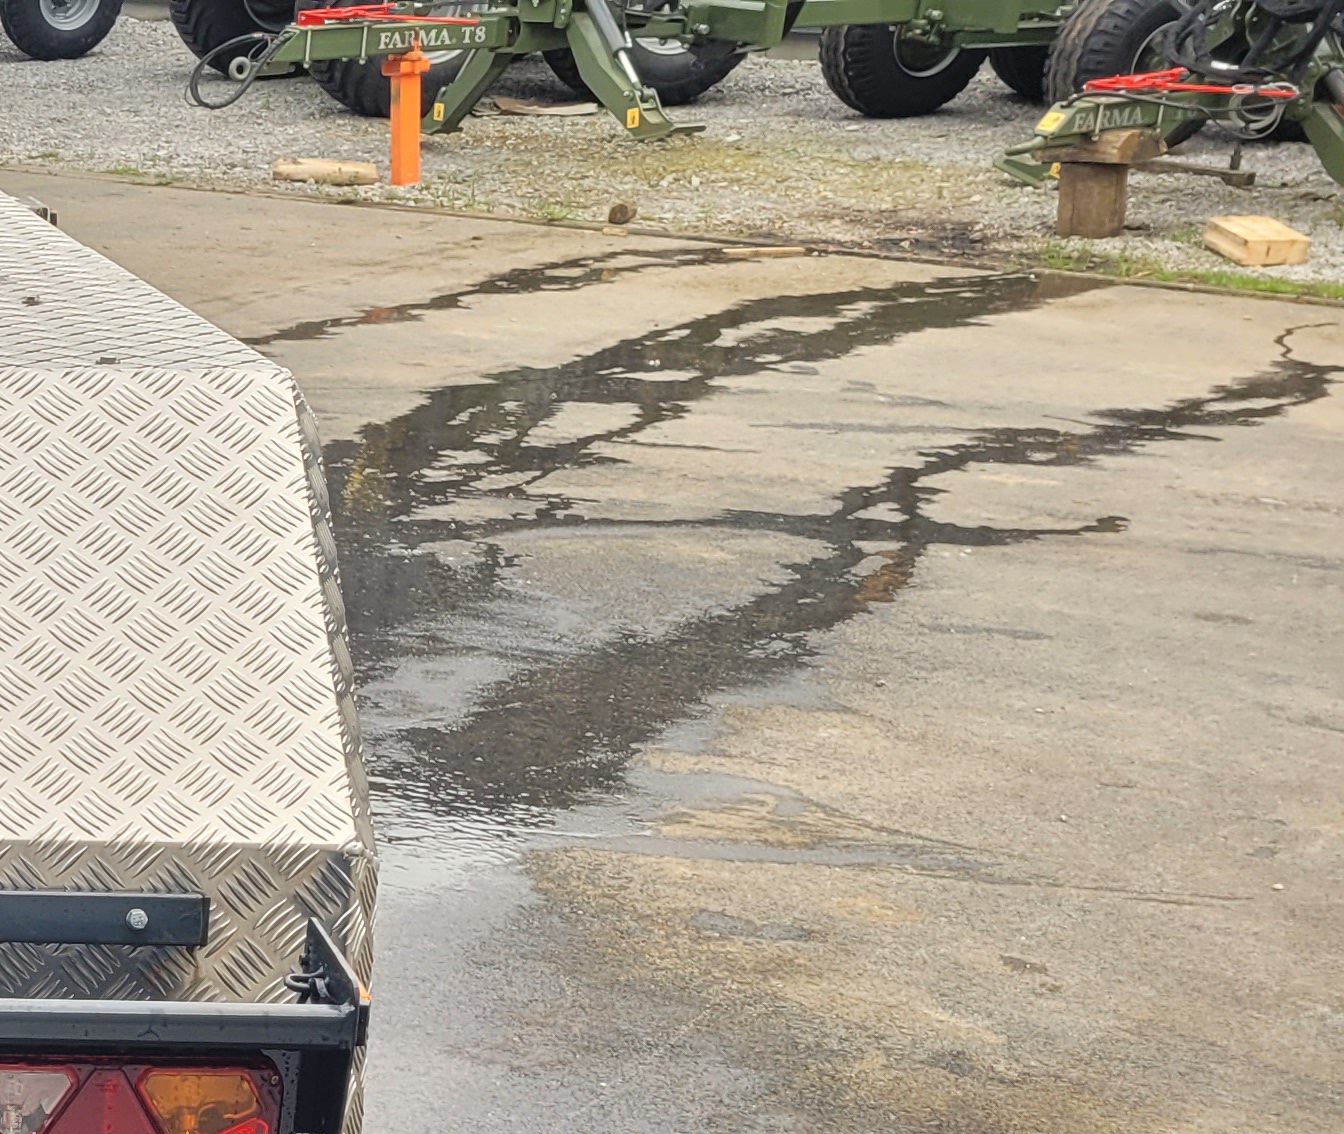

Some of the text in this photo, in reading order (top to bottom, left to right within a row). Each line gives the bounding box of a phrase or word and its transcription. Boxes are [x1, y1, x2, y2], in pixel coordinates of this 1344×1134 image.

[378, 26, 487, 50] FARMA T8
[1072, 106, 1144, 132] FARMA
